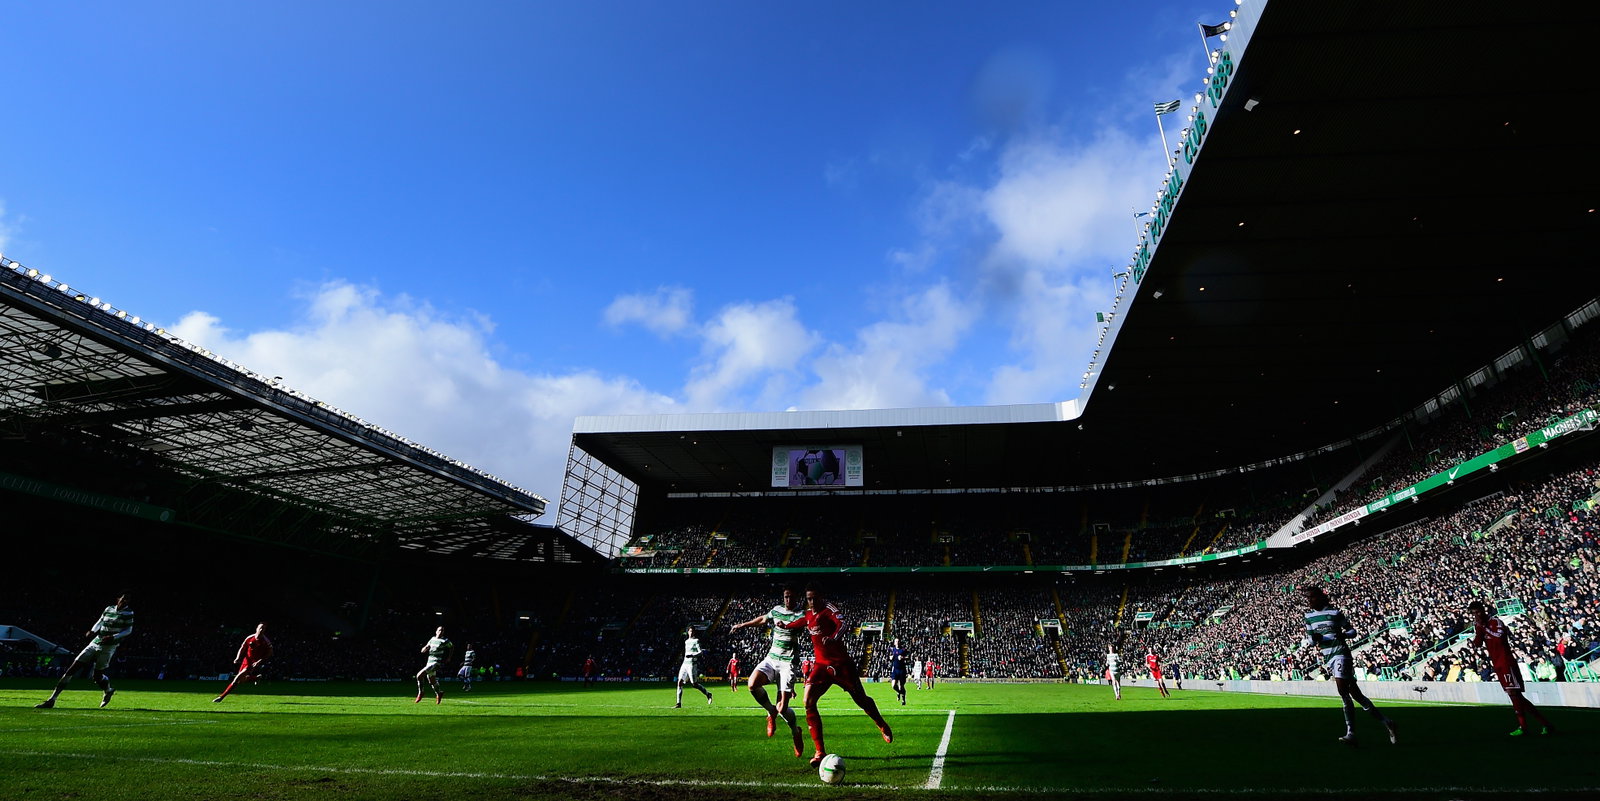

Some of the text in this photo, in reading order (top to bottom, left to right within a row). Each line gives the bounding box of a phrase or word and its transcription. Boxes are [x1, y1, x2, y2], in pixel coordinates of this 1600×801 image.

[1151, 169, 1183, 245] FOOTBALL
[1184, 111, 1207, 165] CLUB
[1207, 51, 1234, 109] 1888
[1541, 415, 1581, 440] MAGNERS
[53, 487, 107, 507] FOOTBALL
[112, 501, 141, 514] CLUB
[1503, 673, 1512, 683] 17
